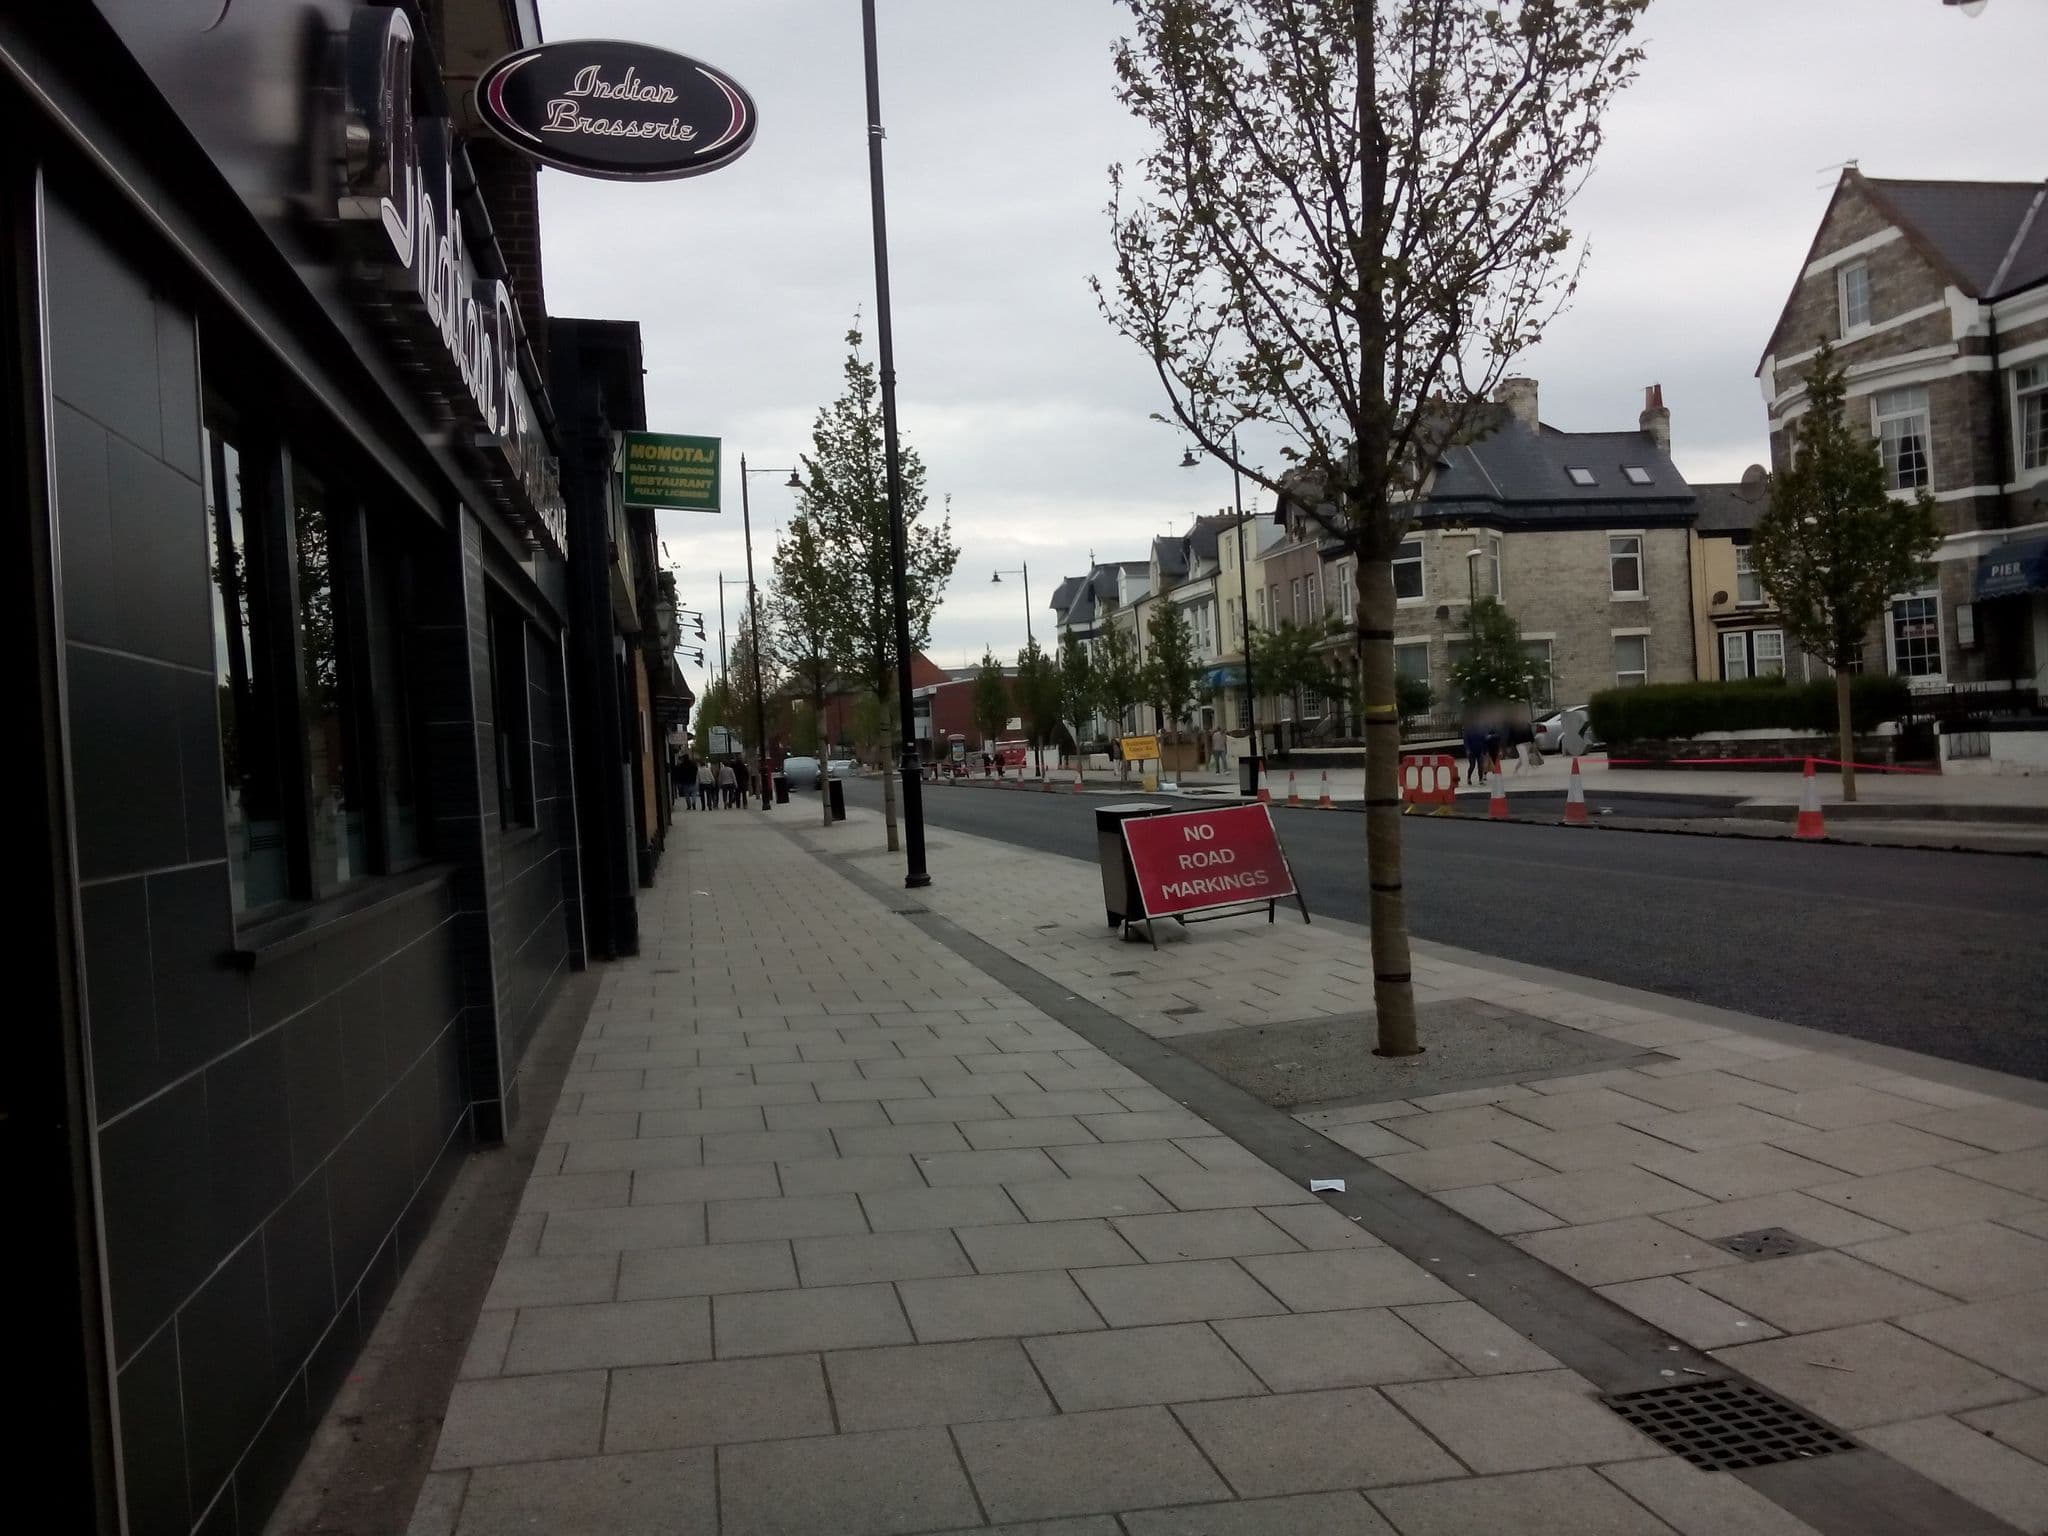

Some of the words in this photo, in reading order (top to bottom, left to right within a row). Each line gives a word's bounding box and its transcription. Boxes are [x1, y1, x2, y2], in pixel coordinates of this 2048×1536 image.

[564, 64, 678, 104] Indian
[541, 98, 698, 142] Brasserie
[630, 444, 715, 463] MOMOTAJ
[631, 475, 713, 489] RESTAURANT
[634, 487, 663, 496] FULLY
[1991, 562, 2021, 577] PIER
[1183, 824, 1215, 842] NO
[1178, 848, 1235, 869] ROAD
[1161, 870, 1269, 899] MARKINGS
